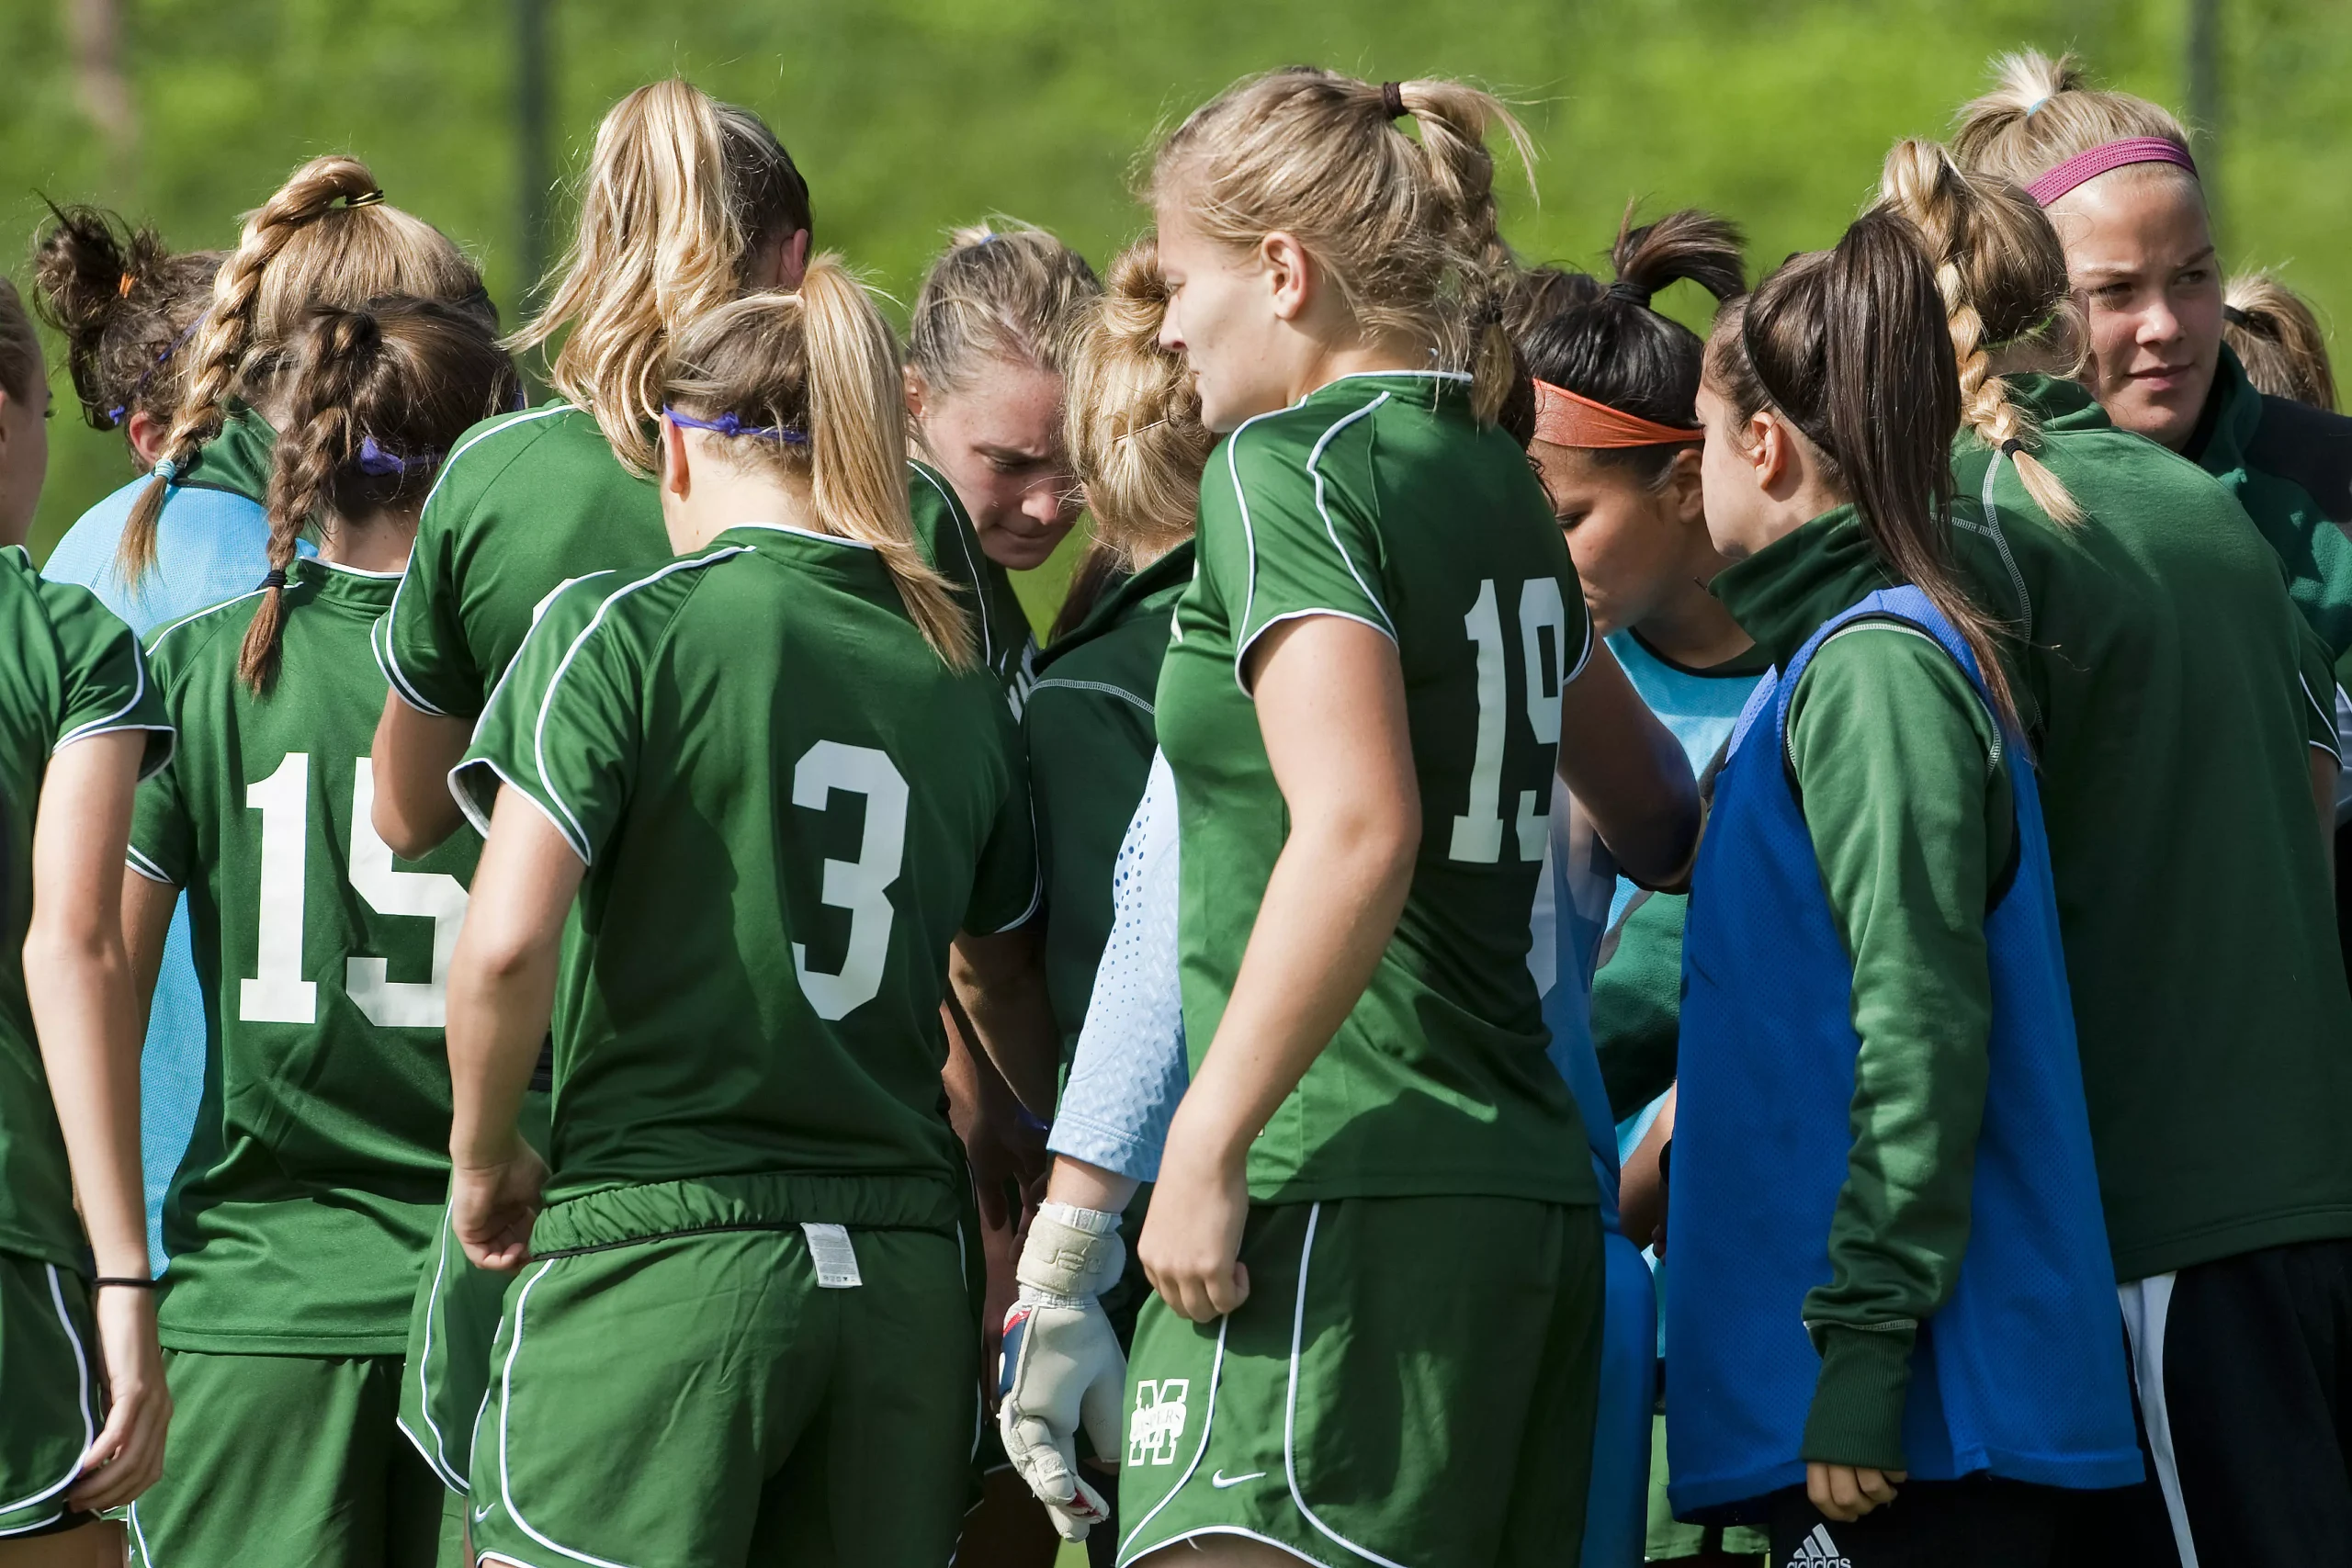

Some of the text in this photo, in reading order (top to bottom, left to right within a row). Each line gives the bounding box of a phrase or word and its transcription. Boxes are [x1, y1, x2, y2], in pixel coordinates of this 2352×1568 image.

[1449, 577, 1565, 863] 19
[239, 751, 470, 1028] 15
[791, 739, 910, 1021] 3
